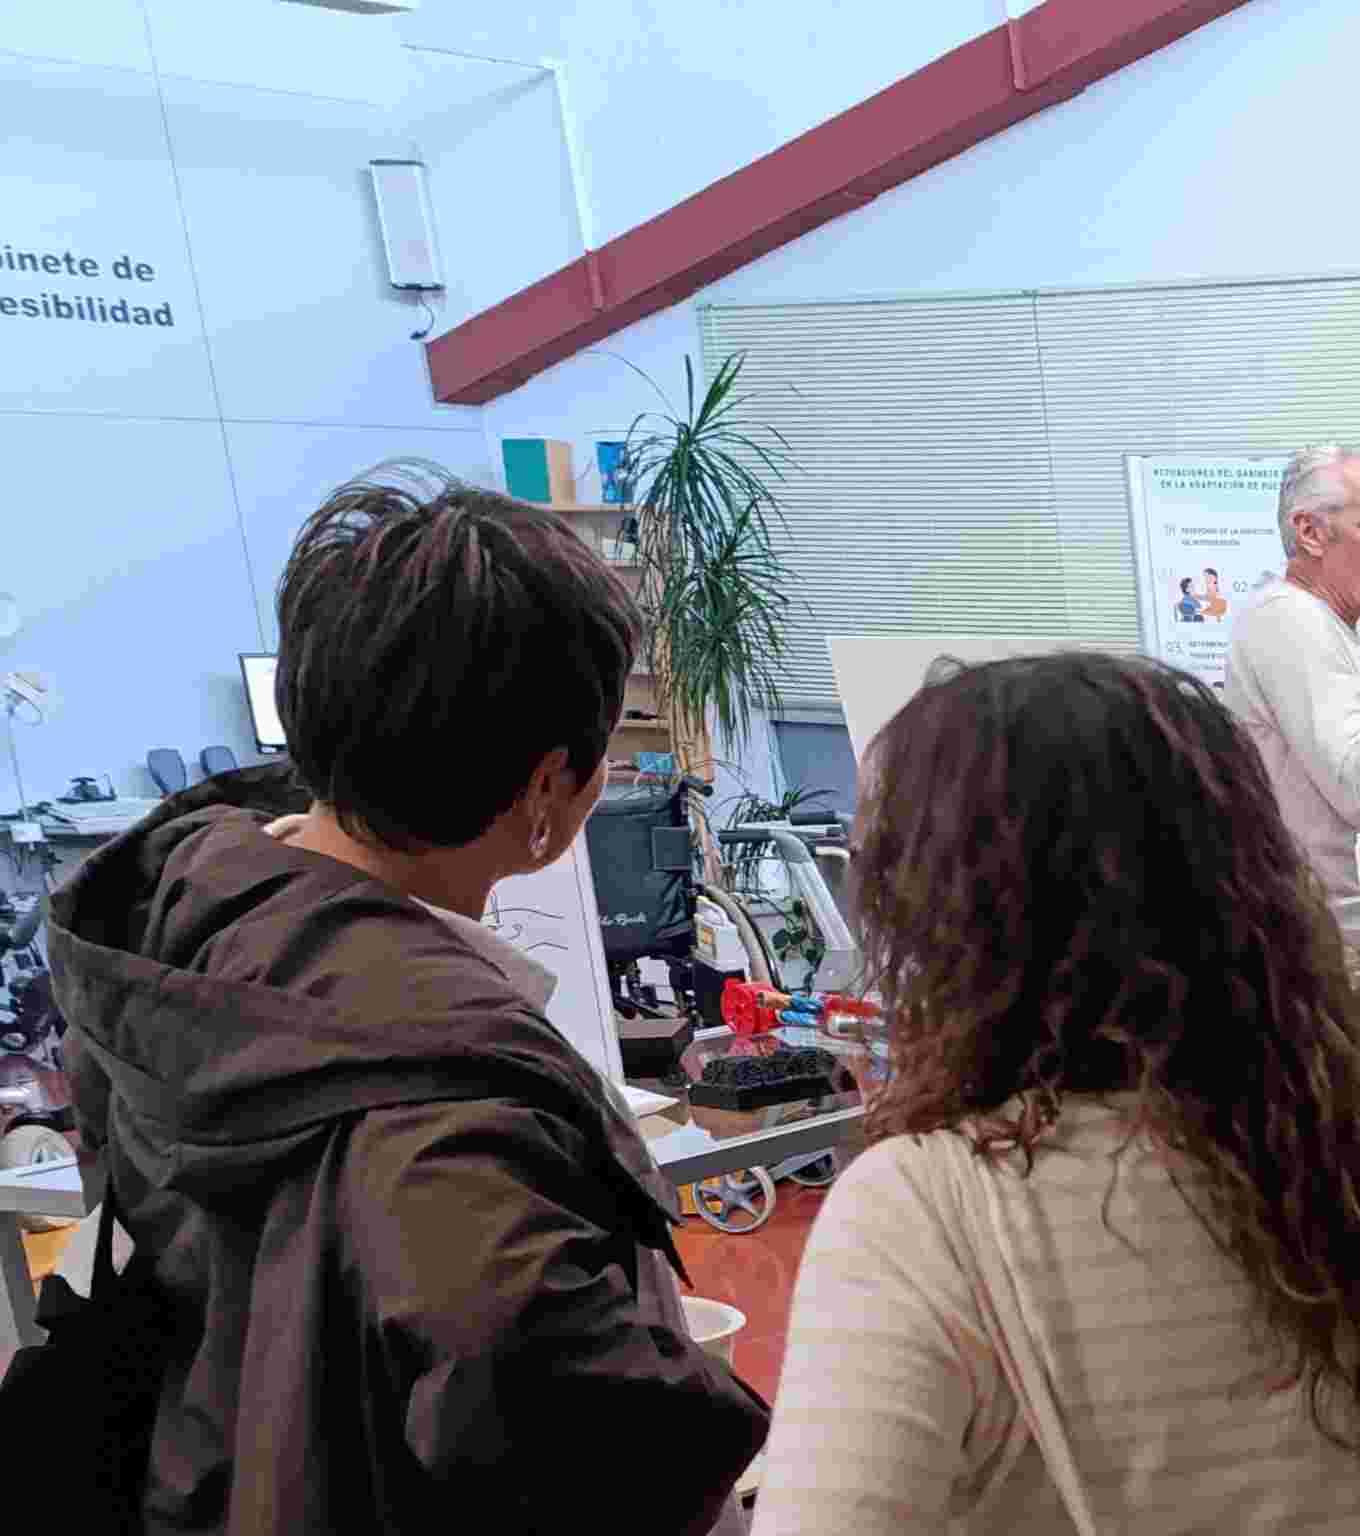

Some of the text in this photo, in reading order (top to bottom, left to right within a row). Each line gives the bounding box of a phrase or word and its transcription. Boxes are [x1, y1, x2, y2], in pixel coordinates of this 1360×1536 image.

[0, 245, 155, 282] inete de
[0, 293, 175, 327] esibilidad
